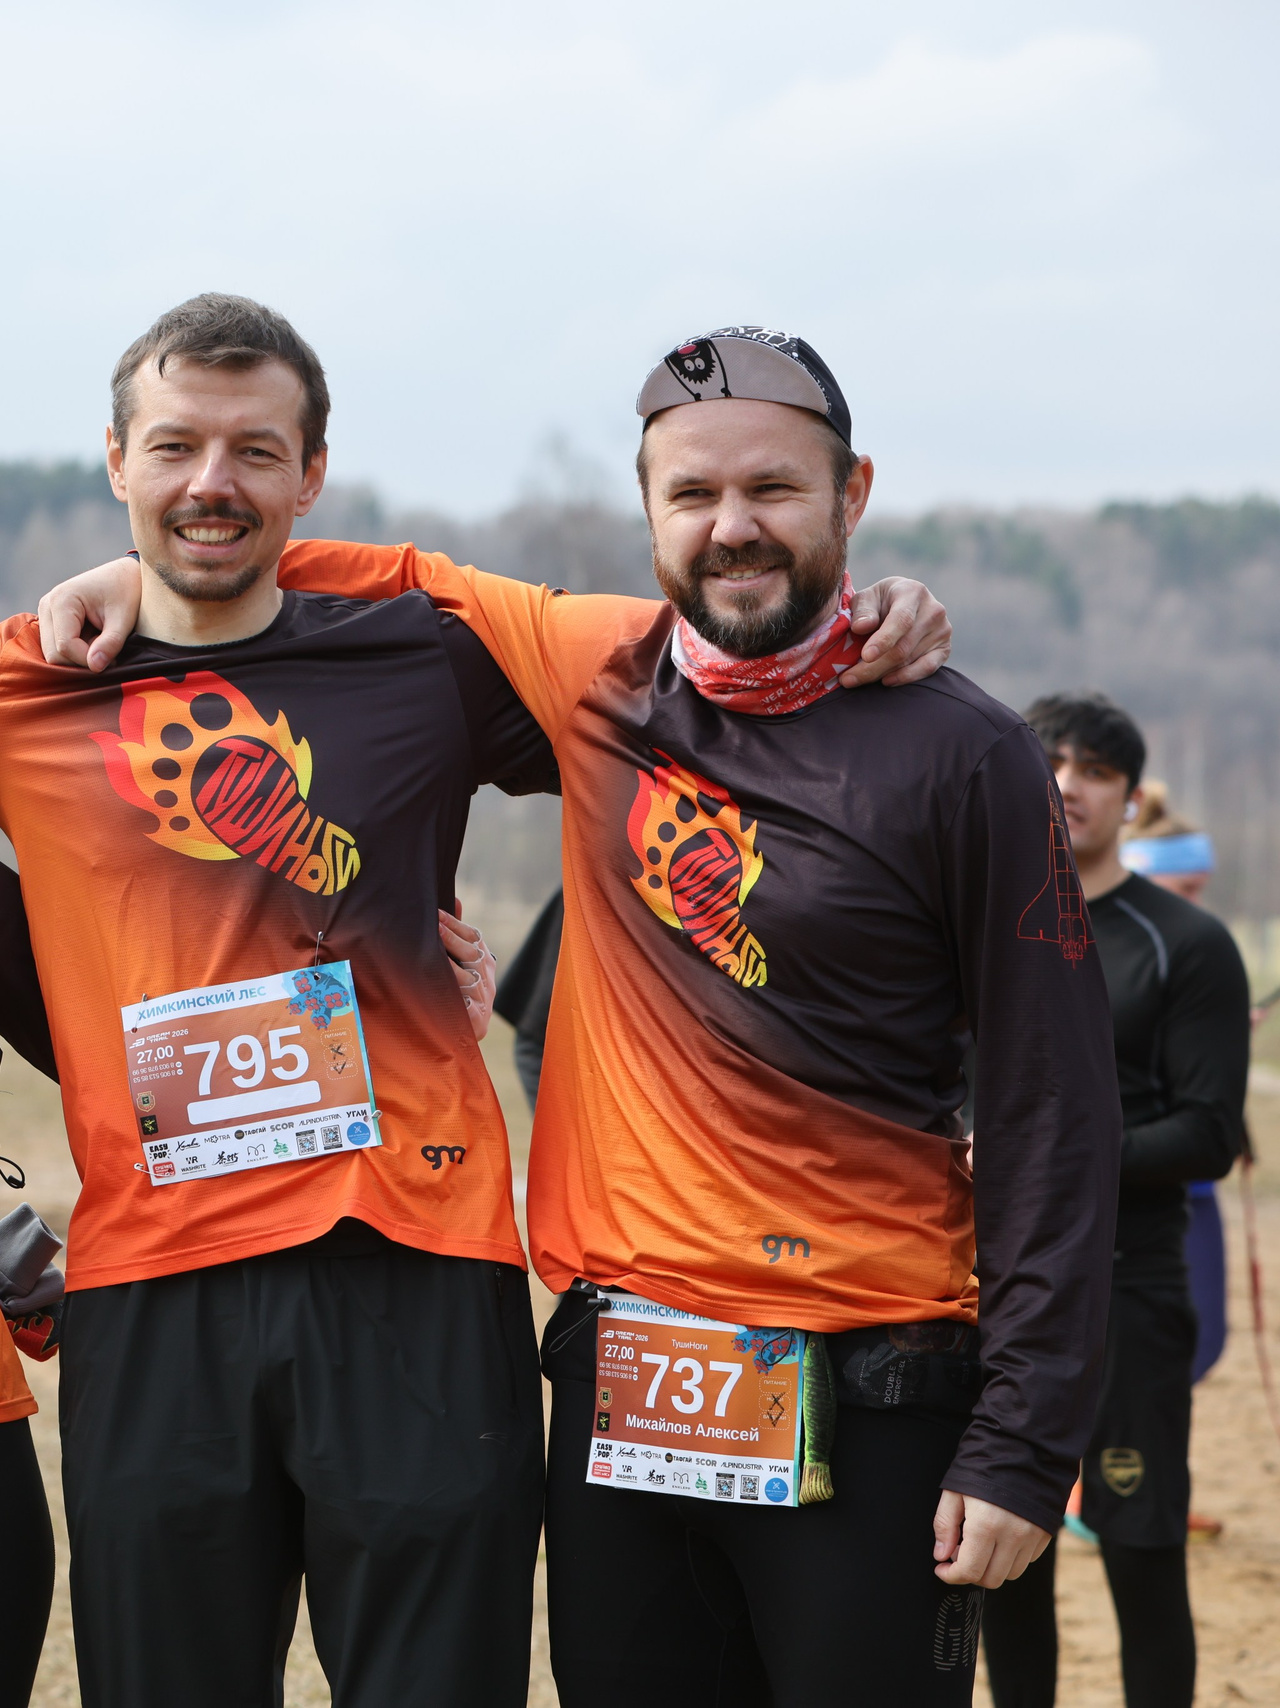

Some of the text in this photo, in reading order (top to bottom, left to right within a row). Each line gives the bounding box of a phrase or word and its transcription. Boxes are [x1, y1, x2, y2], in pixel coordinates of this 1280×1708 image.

[138, 986, 266, 1021] ХИМКИНСКИЙ ЛЕС
[146, 1031, 170, 1041] DREAM
[171, 1029, 189, 1038] 2026
[136, 1045, 174, 1064] 27,00
[183, 1025, 310, 1096] 795
[270, 1121, 295, 1132] SCOR
[149, 1143, 169, 1153] EASY
[153, 1151, 167, 1159] POP
[635, 1334, 649, 1342] 2026
[672, 1339, 708, 1351] ТушиНоги
[604, 1344, 635, 1361] 27,00
[641, 1352, 743, 1418] 737
[883, 1365, 897, 1404] DOUBLE
[625, 1413, 759, 1441] Михайлов Алексей
[596, 1442, 613, 1451] EASY
[597, 1451, 610, 1459] POP
[695, 1457, 717, 1467] SCOR
